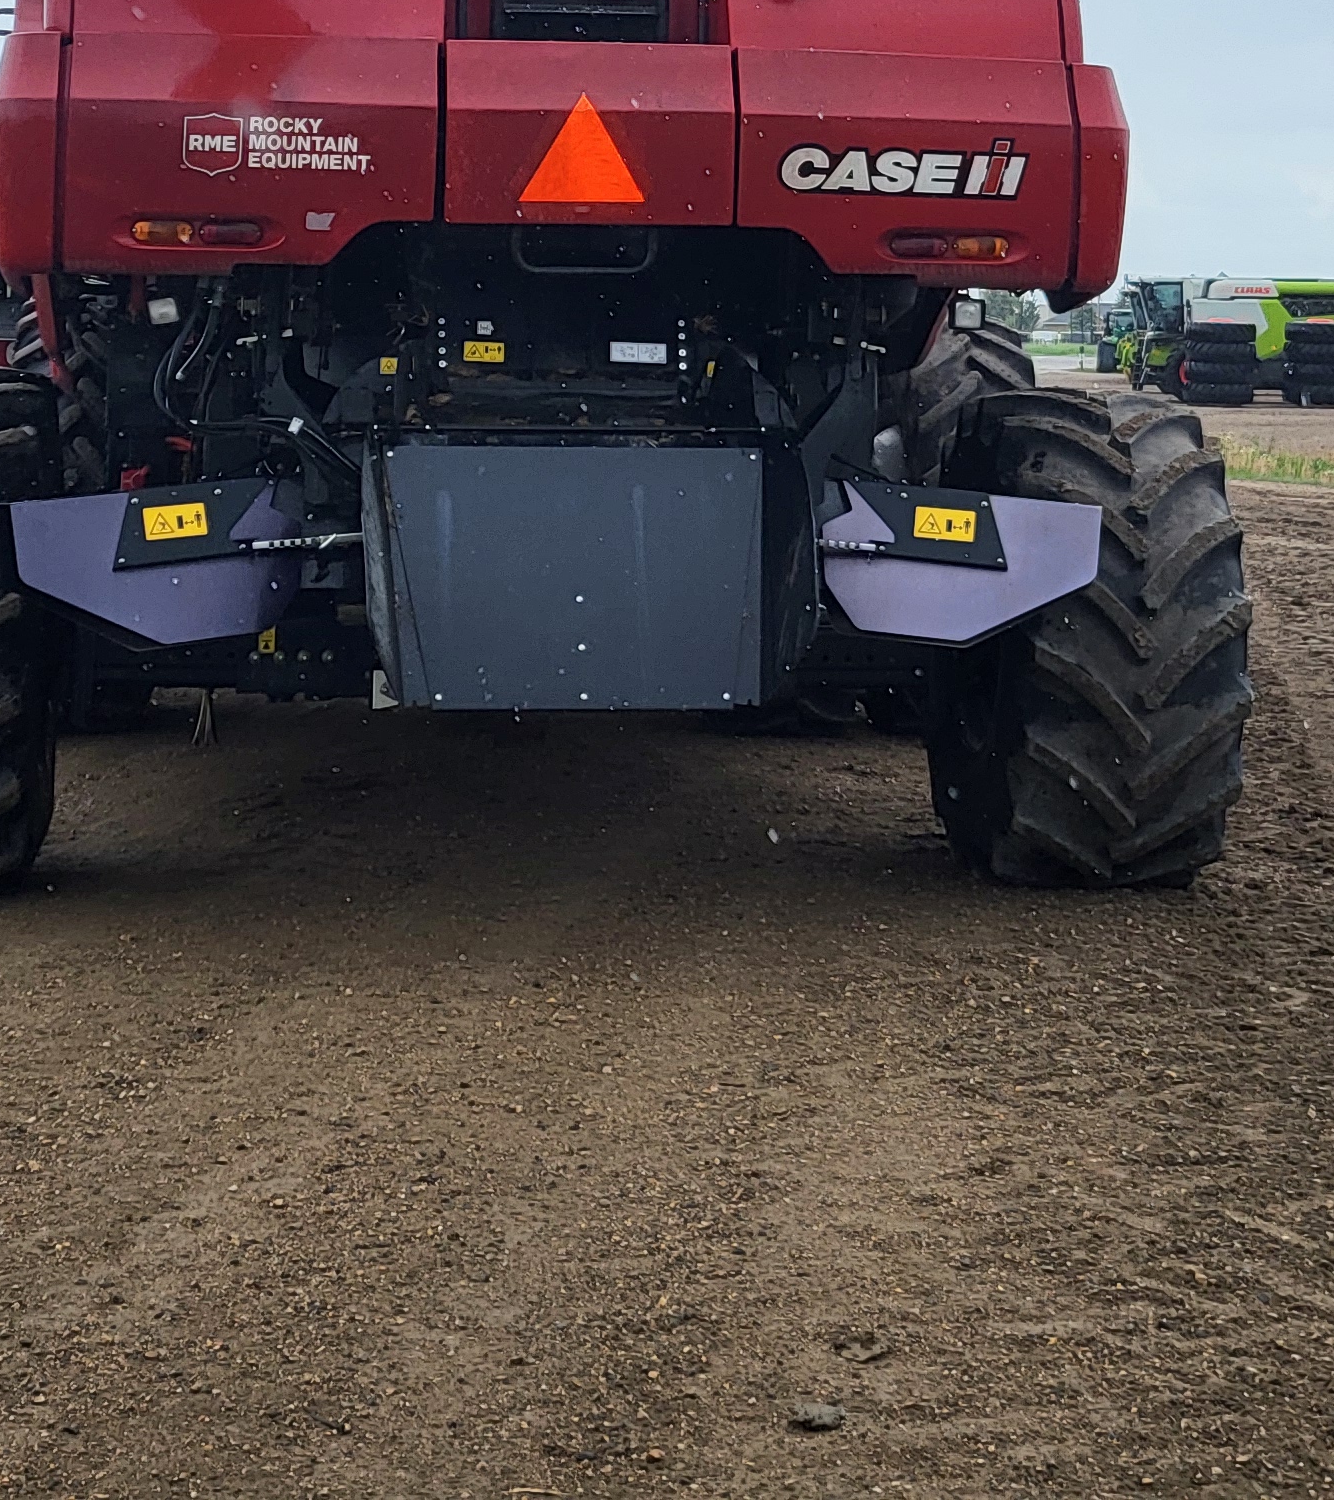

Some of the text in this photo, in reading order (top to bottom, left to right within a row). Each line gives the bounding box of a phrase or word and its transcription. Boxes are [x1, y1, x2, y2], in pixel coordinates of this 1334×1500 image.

[249, 116, 323, 134] ROCKY
[188, 134, 237, 152] RME
[248, 134, 359, 153] MOUNTAIN
[247, 152, 372, 172] EQUIPMENT
[781, 147, 963, 193] CASE
[1233, 285, 1272, 295] CLAAS
